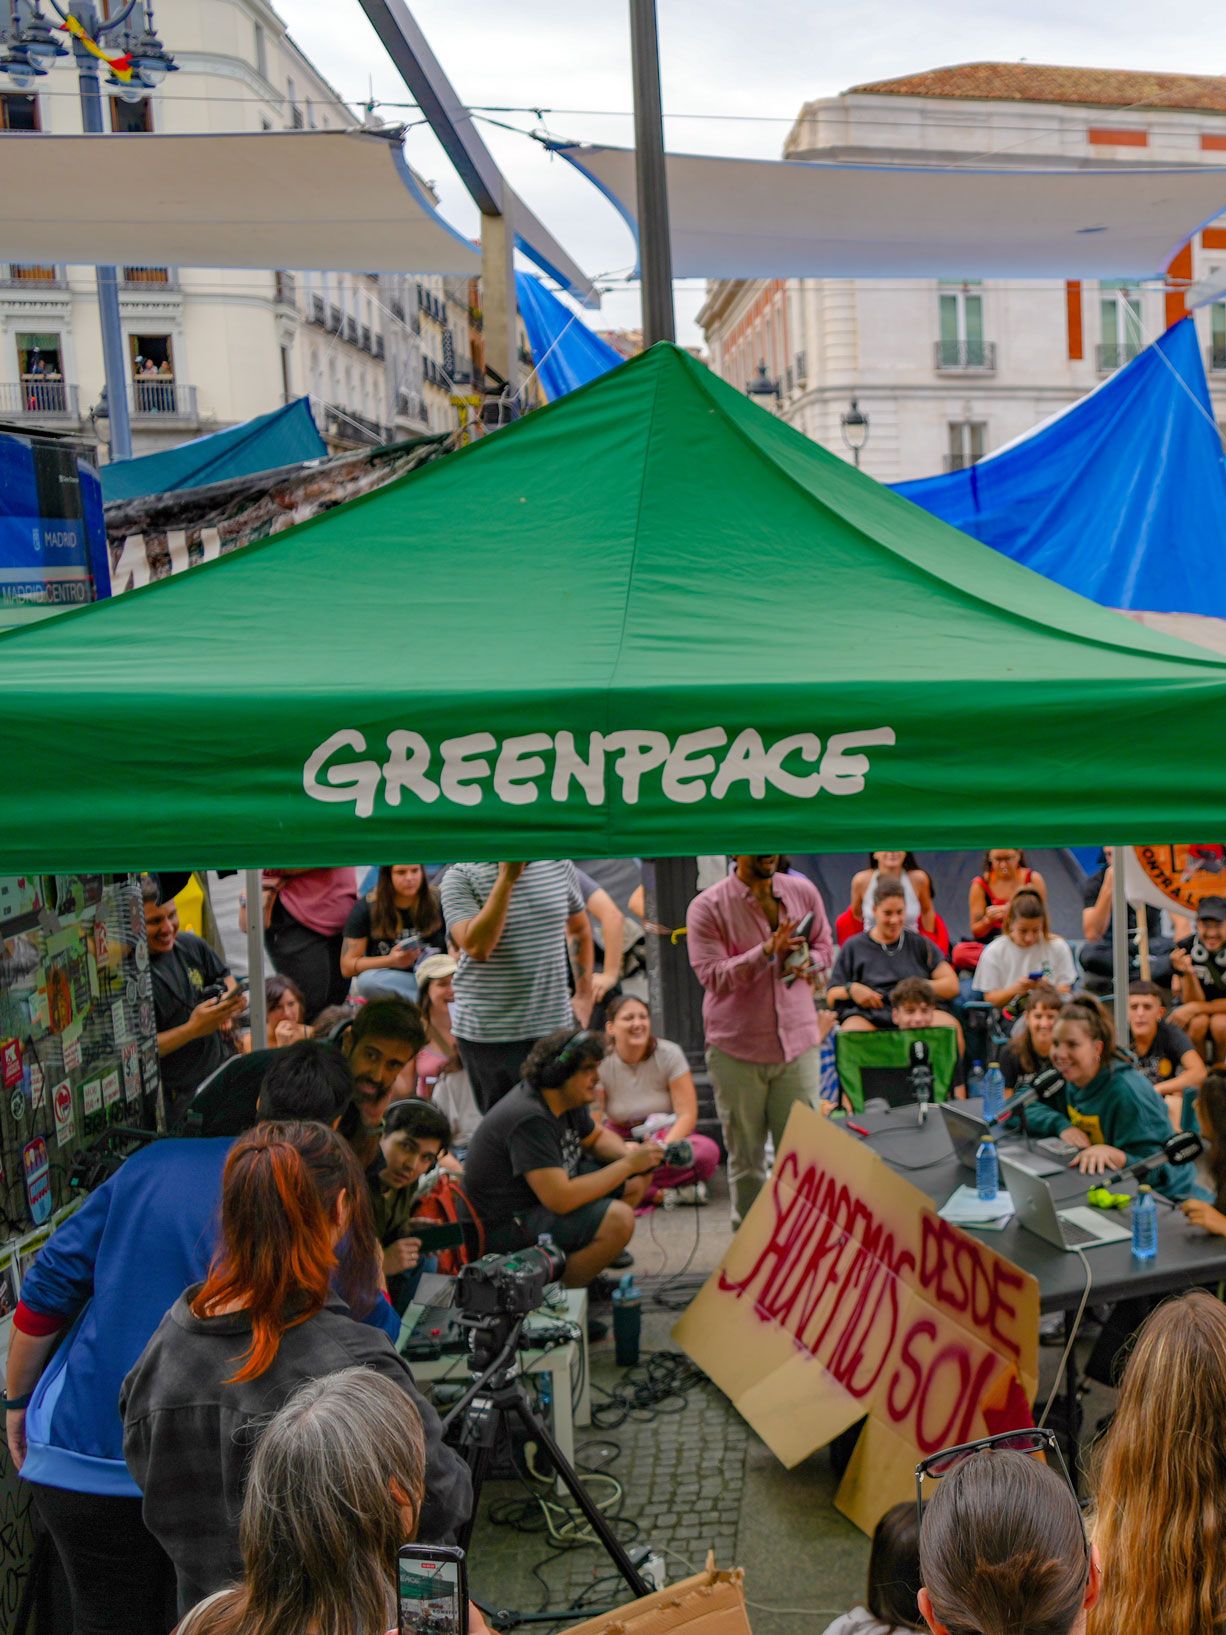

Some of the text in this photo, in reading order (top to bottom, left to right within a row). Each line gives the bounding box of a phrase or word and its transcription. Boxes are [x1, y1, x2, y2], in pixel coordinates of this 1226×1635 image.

[44, 532, 77, 549] MADRID
[46, 581, 85, 600] CENTRO
[302, 726, 897, 818] GREENPEACE
[918, 1213, 1024, 1358] DESDE
